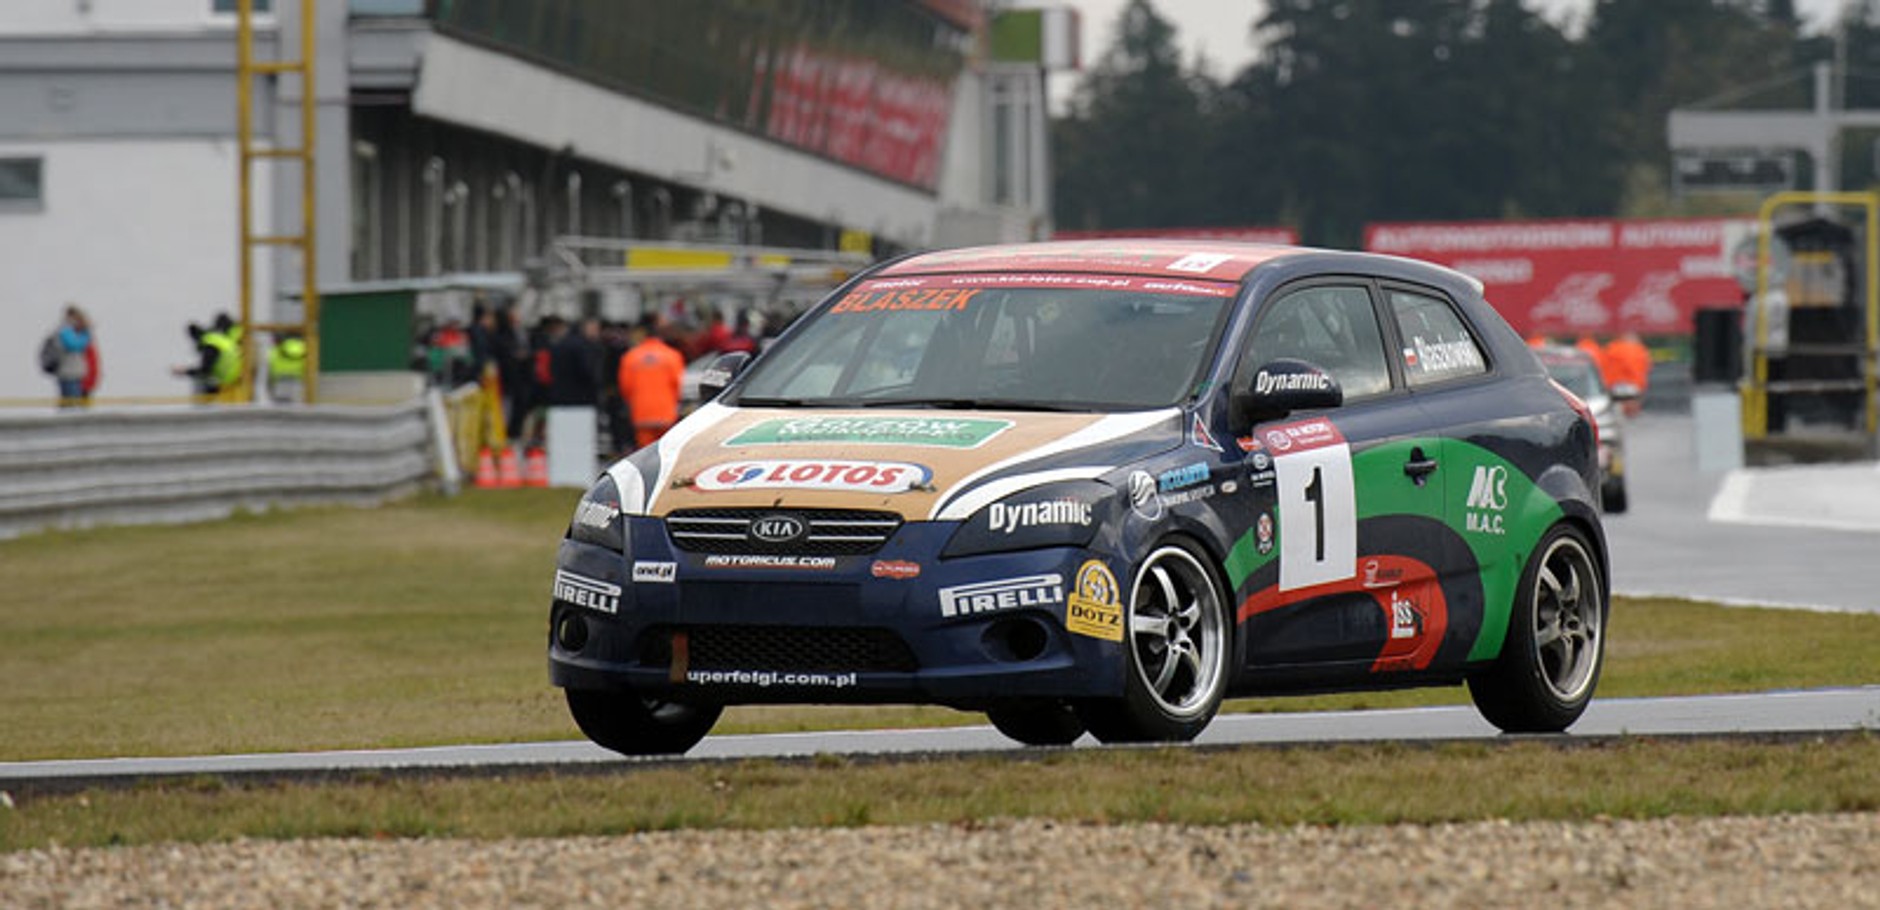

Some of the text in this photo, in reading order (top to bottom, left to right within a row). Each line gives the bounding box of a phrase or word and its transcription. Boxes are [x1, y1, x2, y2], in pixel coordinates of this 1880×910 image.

[1255, 369, 1330, 394] Dynamic
[765, 464, 905, 486] LOTOS
[989, 498, 1092, 533] Dynamic
[1304, 466, 1325, 562] 1
[1466, 512, 1506, 534] M.A.C.
[759, 522, 794, 536] KIA
[554, 569, 622, 614] PIRELLI
[938, 573, 1064, 617] PIRELLI
[1070, 603, 1121, 626] DOTZ
